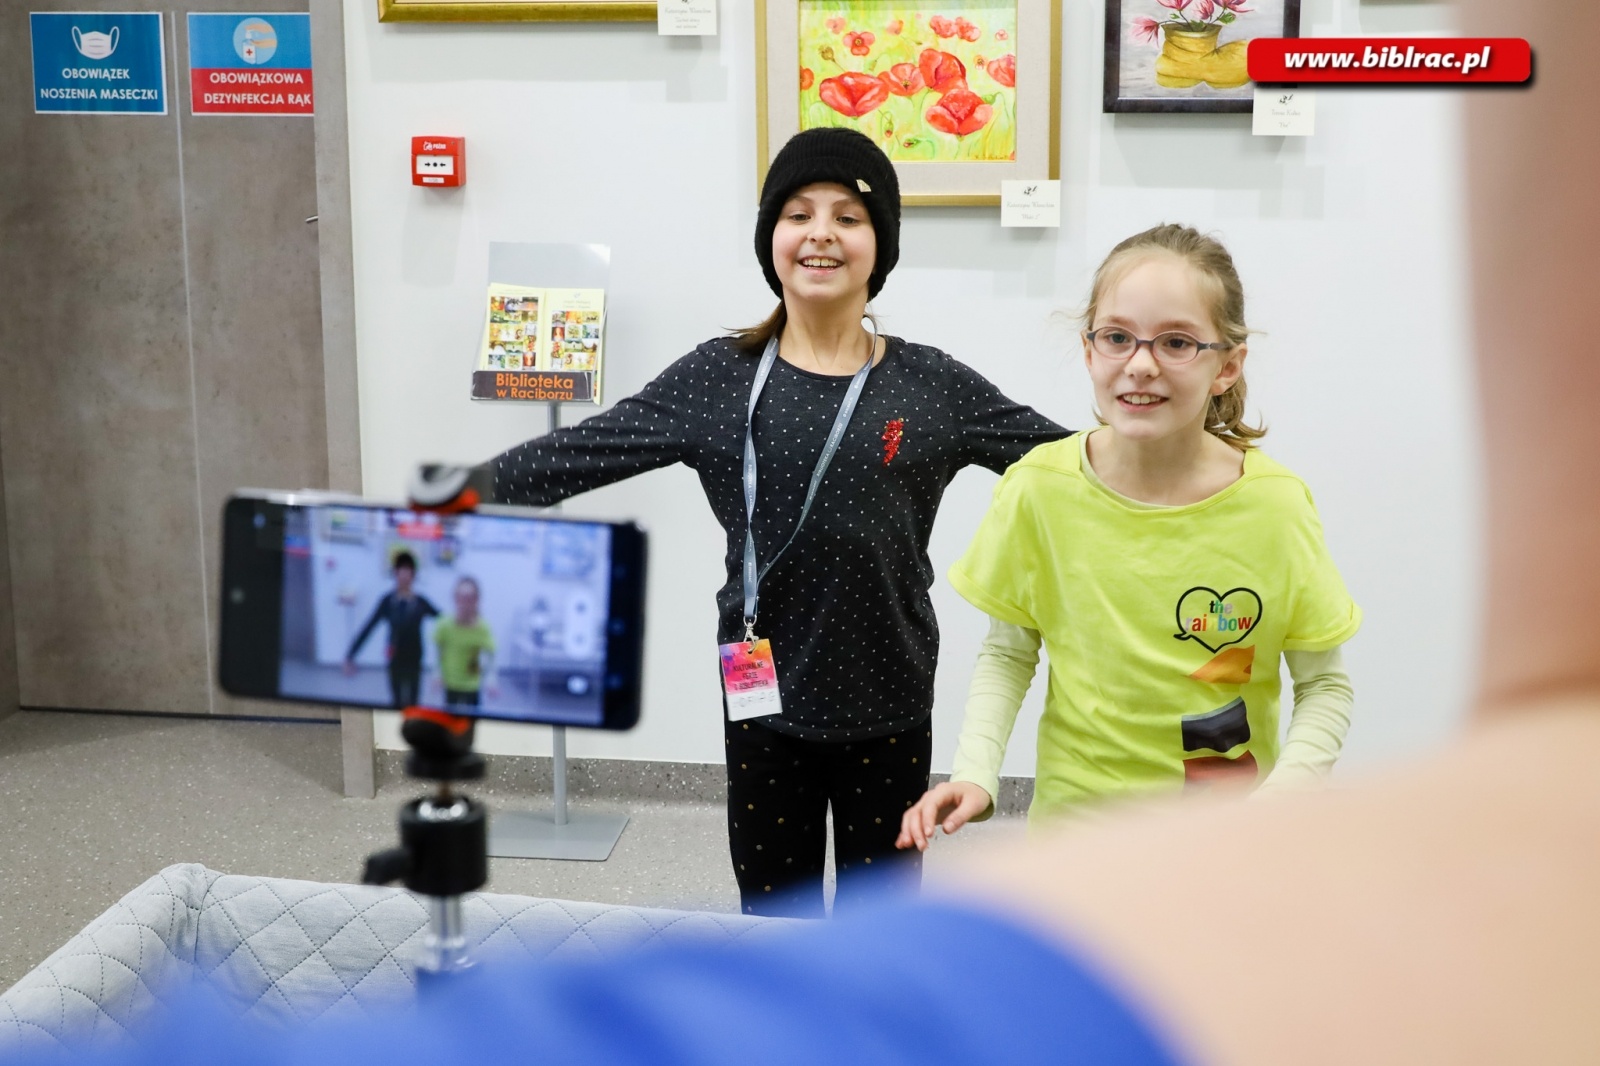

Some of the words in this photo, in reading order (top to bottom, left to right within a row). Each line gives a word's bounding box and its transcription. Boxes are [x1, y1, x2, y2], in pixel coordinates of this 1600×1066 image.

[62, 68, 130, 81] OBOWIĄZEK
[210, 72, 303, 86] OBOWIĄZKOWA
[40, 88, 97, 99] NOSZENIA
[100, 89, 158, 100] MASECZKI
[204, 93, 284, 105] DEZYNFEKCJA
[288, 93, 311, 107] RĄK
[496, 373, 574, 389] Biblioteka
[496, 389, 507, 398] w
[511, 388, 573, 400] Raciborzu
[1209, 600, 1233, 614] the
